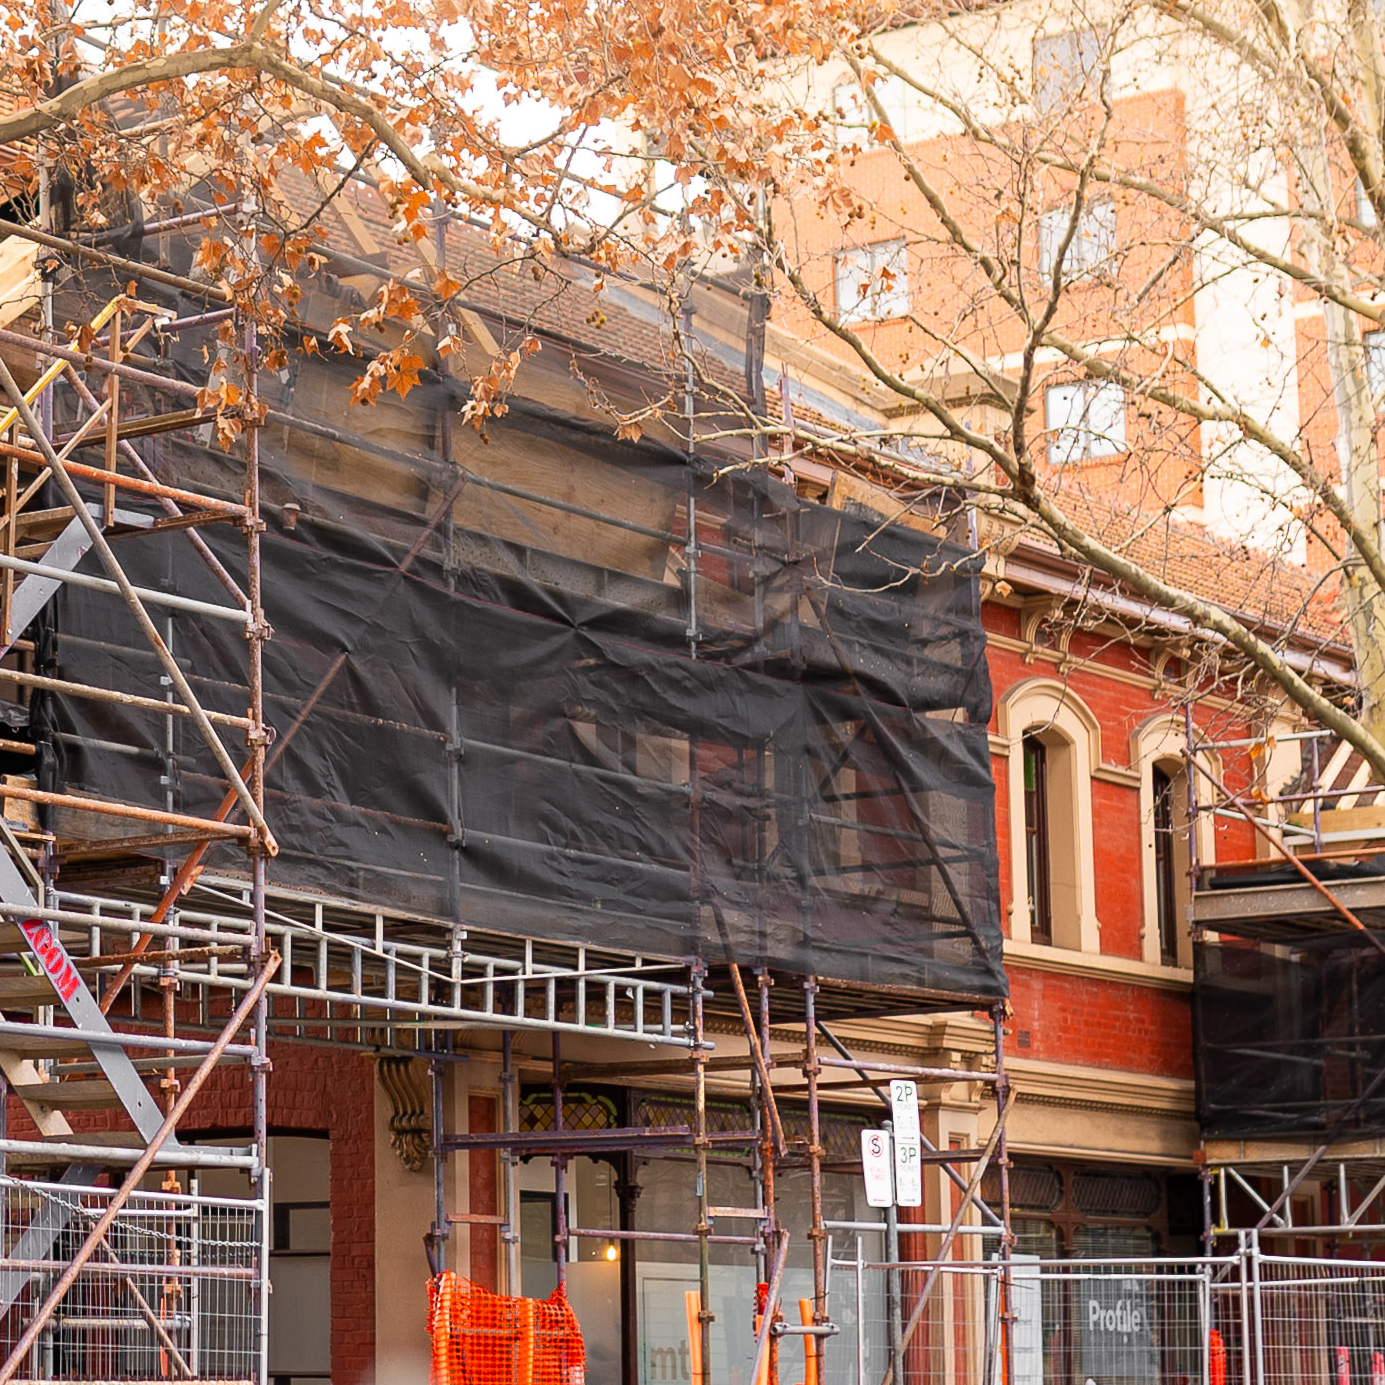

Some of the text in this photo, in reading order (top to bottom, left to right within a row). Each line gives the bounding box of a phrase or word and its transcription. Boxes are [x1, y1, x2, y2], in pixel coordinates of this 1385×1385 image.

[896, 1085, 913, 1102] 2P
[900, 1147, 917, 1164] 3P
[1088, 1299, 1141, 1333] Profile
